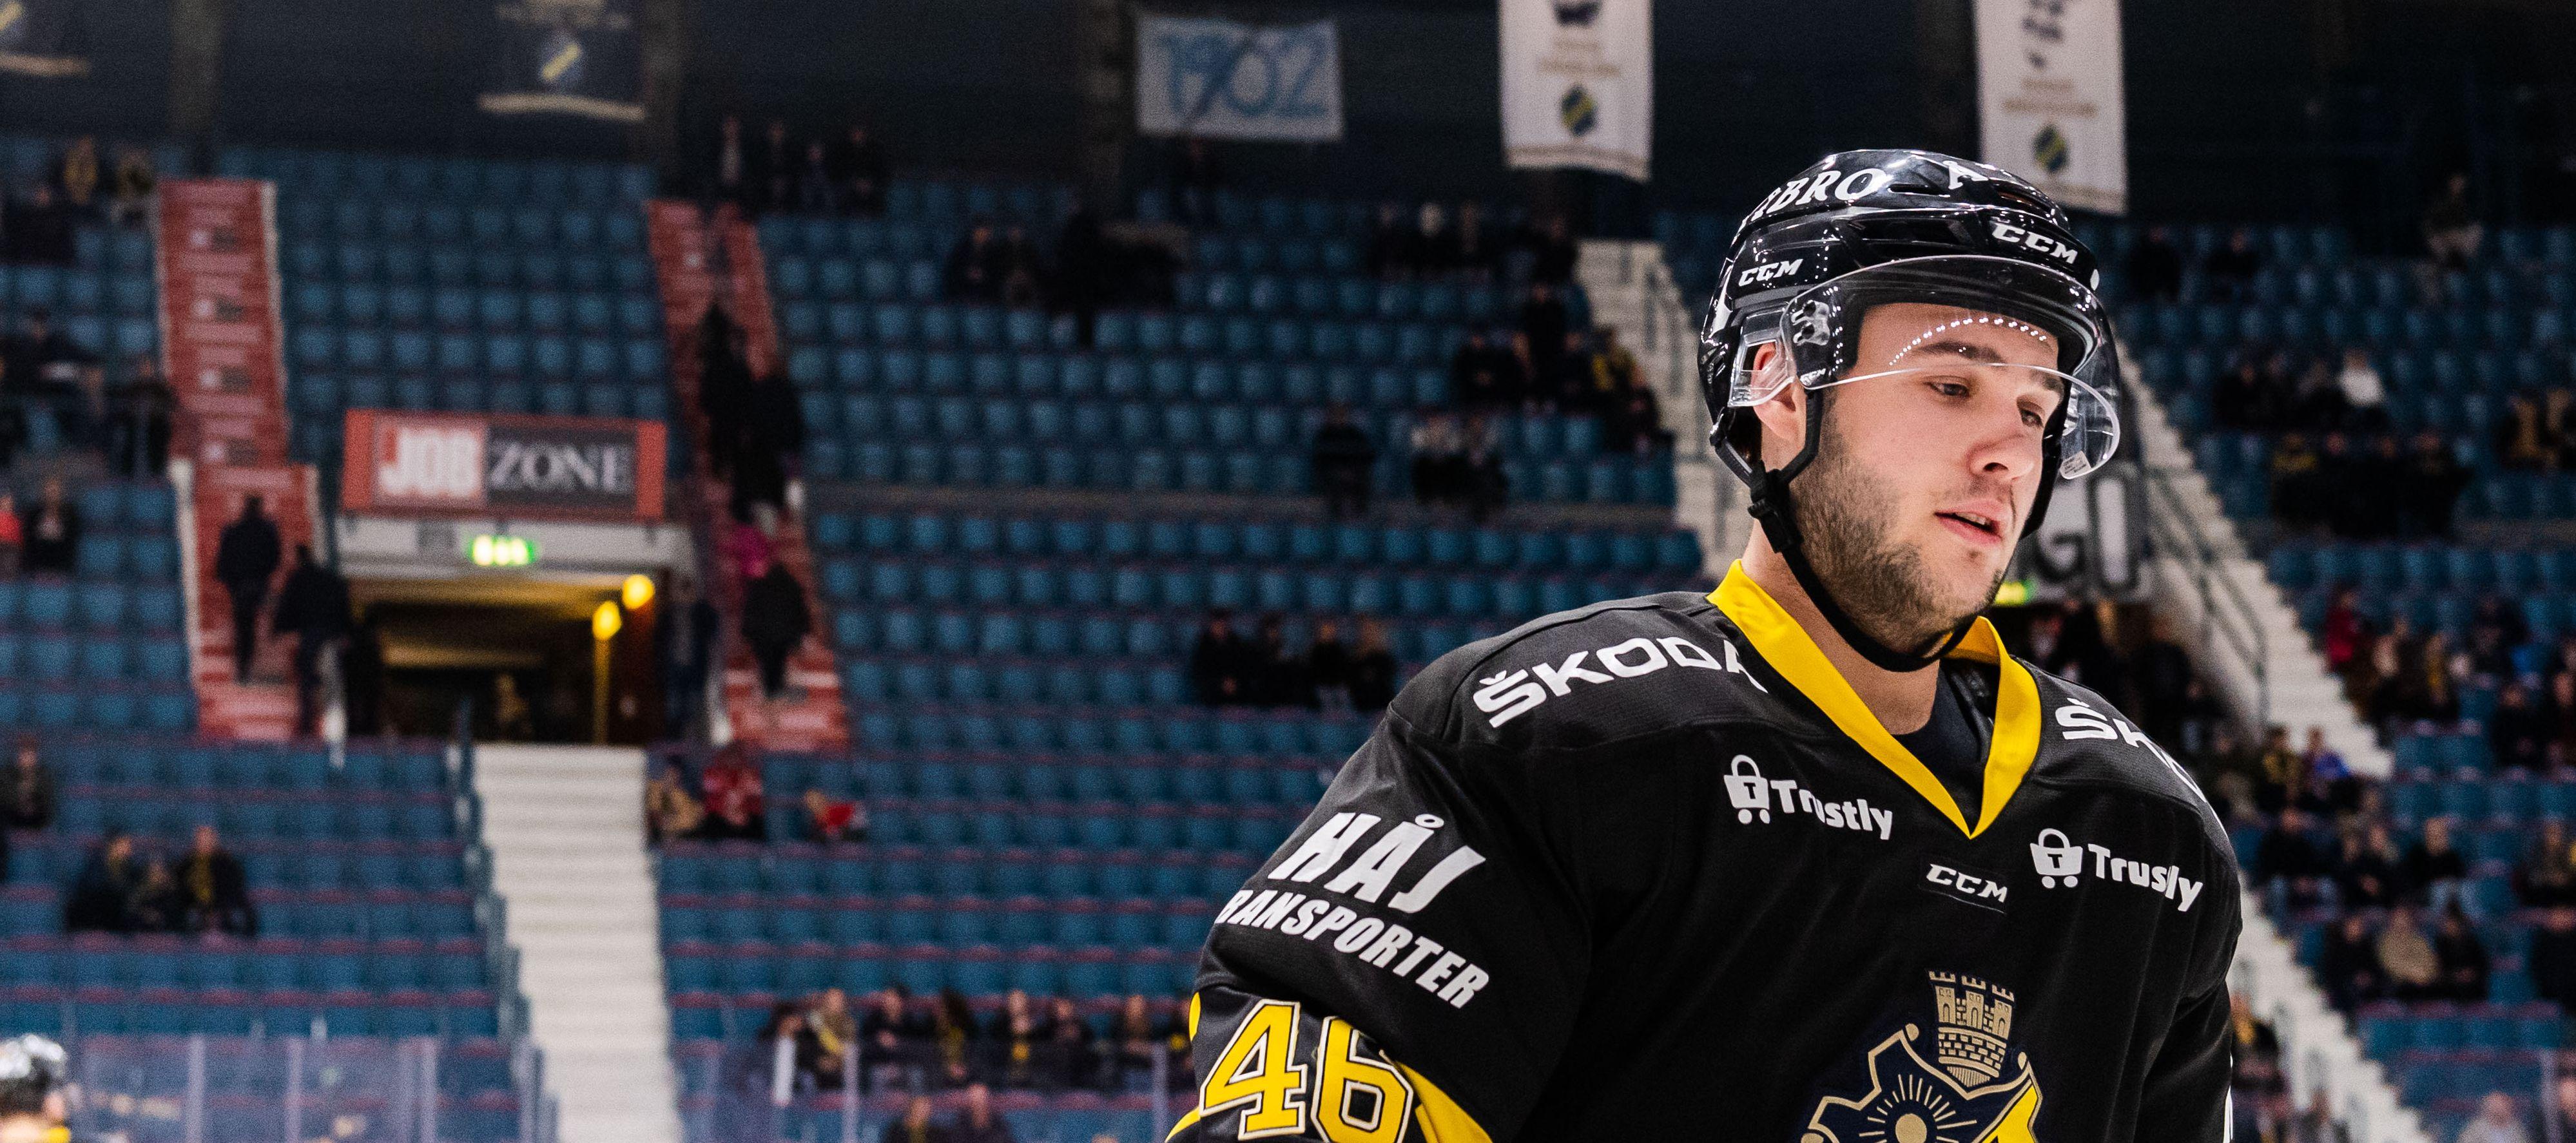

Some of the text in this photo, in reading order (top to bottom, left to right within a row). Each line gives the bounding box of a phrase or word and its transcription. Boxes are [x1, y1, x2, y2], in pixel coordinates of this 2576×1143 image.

[1738, 259, 1804, 287] CCM
[1991, 223, 2078, 264] CCM
[378, 428, 634, 497] JOB ZONE
[1473, 637, 1768, 728] ŠKODA
[1770, 780, 1893, 840] Trustly
[1268, 812, 1486, 914] HÅJ
[1926, 863, 2008, 903] CCM
[1214, 890, 1489, 1009] RANSPORTER
[1199, 999, 1413, 1143] 46
